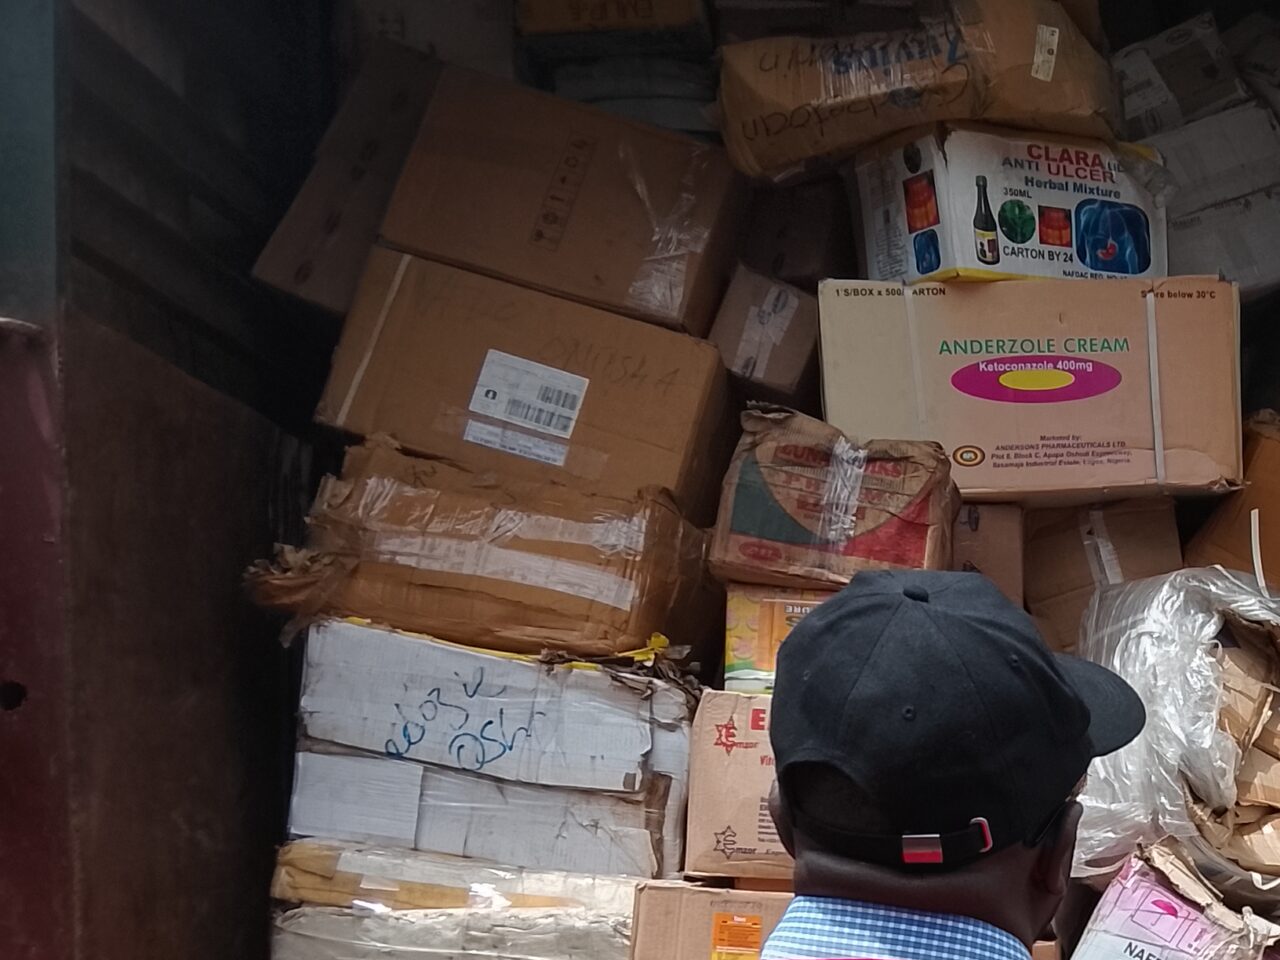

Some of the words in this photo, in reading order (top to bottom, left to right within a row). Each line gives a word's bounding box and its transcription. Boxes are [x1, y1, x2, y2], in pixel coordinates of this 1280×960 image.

[1026, 143, 1104, 169] CLARA
[1002, 156, 1040, 172] ANTI
[1046, 163, 1115, 183] ULCER
[1003, 187, 1032, 198] 350ML
[1024, 175, 1069, 193] Herbal
[1072, 182, 1121, 199] Mixture
[1002, 245, 1045, 261] CARTON
[1048, 251, 1062, 262] BY
[1062, 252, 1074, 264] 24
[877, 289, 884, 297] x
[1166, 290, 1193, 299] below
[1195, 290, 1217, 300] 30°C
[939, 338, 1056, 355] ANDERZOLE
[1064, 337, 1130, 353] CREAM
[978, 360, 1054, 372] Ketoconazole
[1056, 360, 1093, 373] 400mg
[995, 443, 1040, 451] ANDERSONS
[1041, 440, 1111, 450] PHARMACEUTICALS
[1112, 440, 1126, 448] LTD
